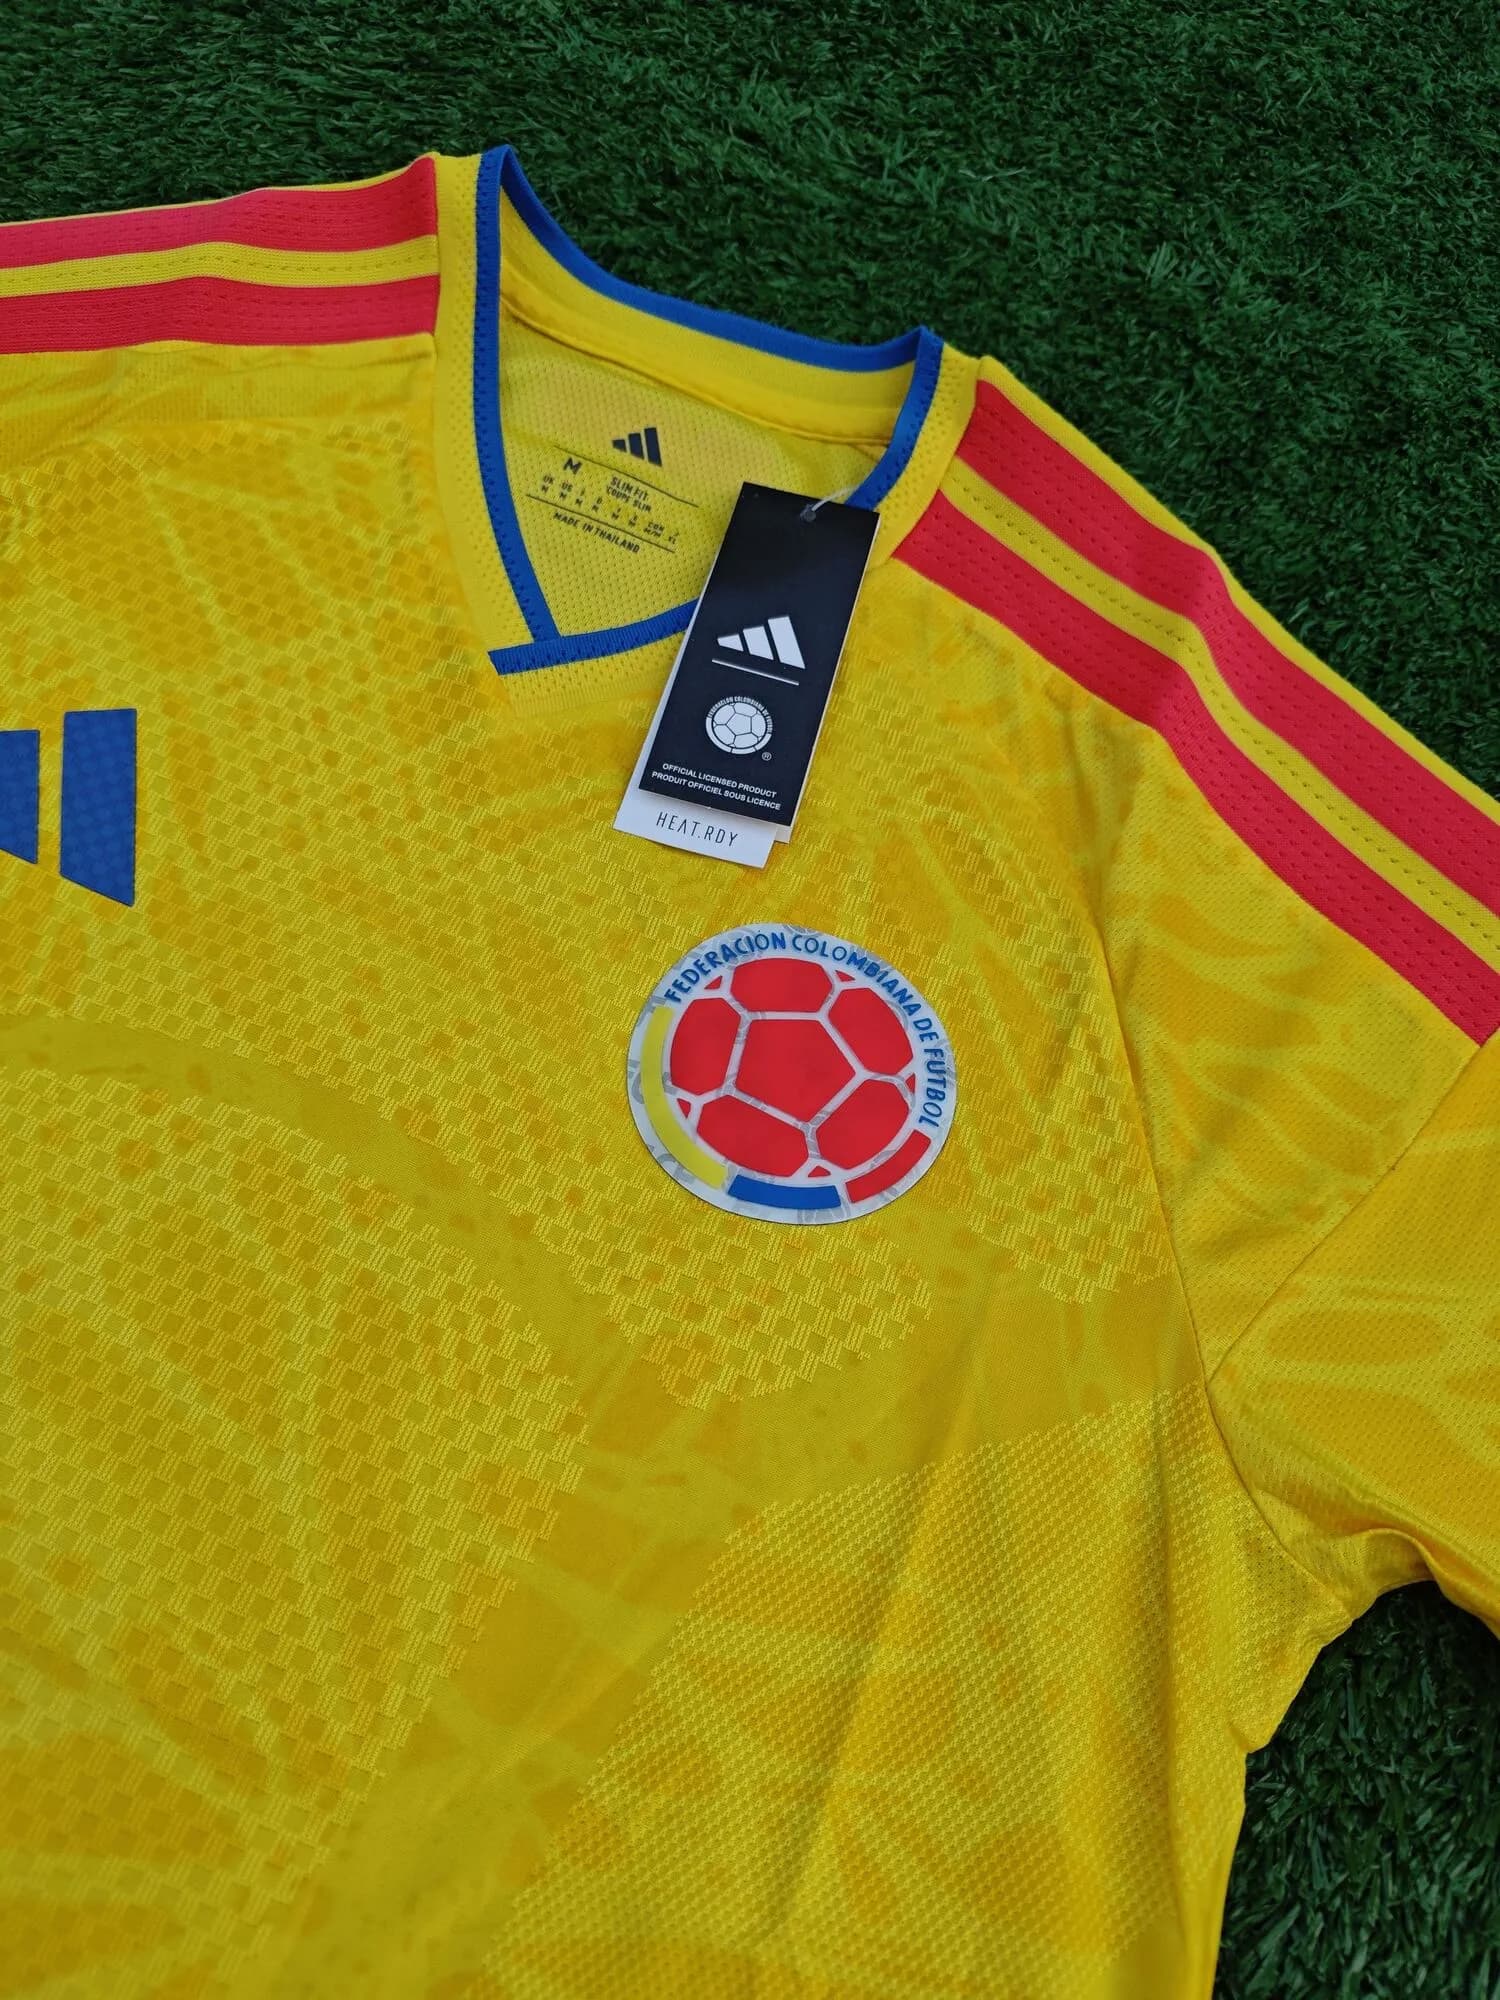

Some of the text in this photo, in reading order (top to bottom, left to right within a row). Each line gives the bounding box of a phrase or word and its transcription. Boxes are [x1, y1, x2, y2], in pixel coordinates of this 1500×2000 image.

[563, 457, 583, 475] M
[611, 476, 648, 501] SLIM FIT
[553, 512, 640, 554] MADE IN THAILAND
[652, 771, 781, 811] PRODUIT OFFICIEL SOUS LICENCE
[662, 763, 777, 799] OFFICIAL LICENSED PRODUCT
[656, 811, 739, 847] HEAT.RDY
[791, 933, 922, 1017] COLOMBIANA
[912, 1017, 940, 1043] DE
